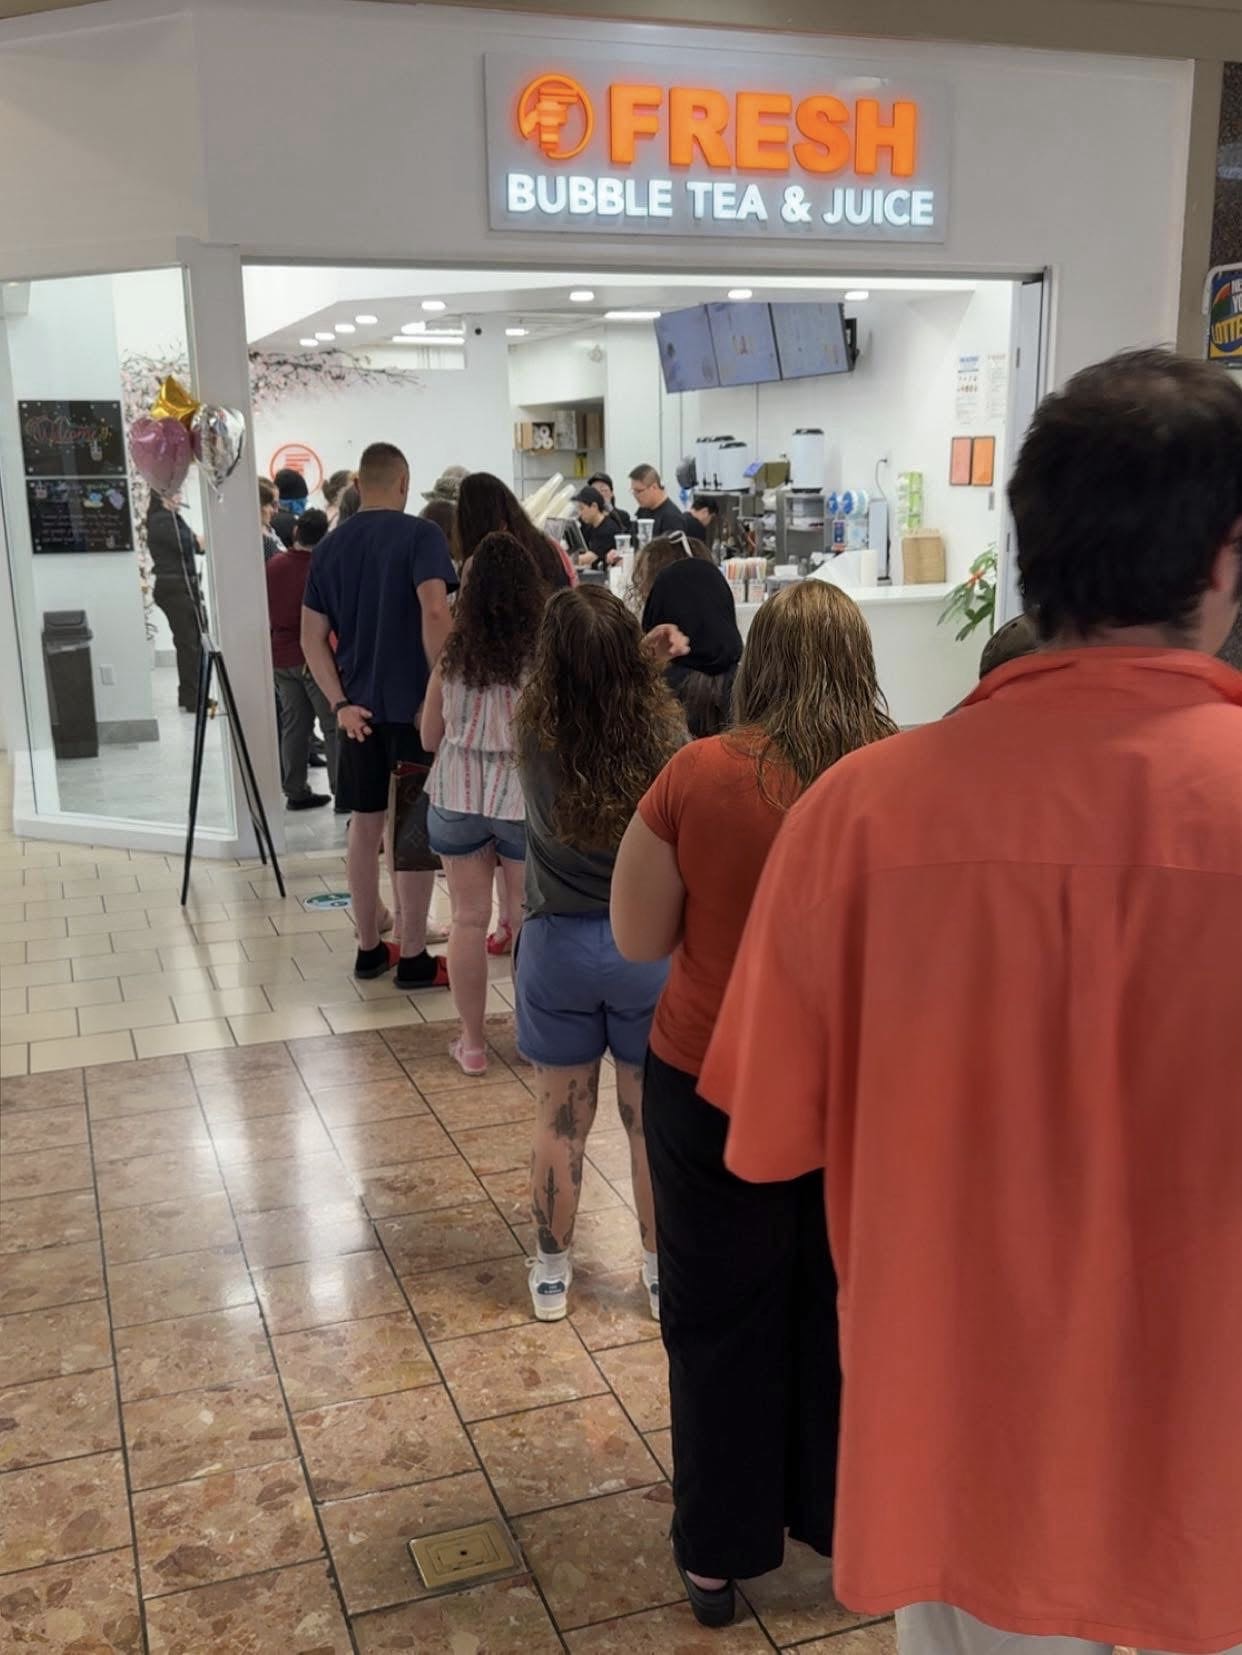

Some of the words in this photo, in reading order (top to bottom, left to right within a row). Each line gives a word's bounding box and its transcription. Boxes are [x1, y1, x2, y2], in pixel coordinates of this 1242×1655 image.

[609, 84, 917, 176] FRESH
[507, 173, 673, 218] BUBBLE
[687, 181, 768, 221] TEA
[781, 185, 812, 224] &
[823, 187, 935, 226] JUICE
